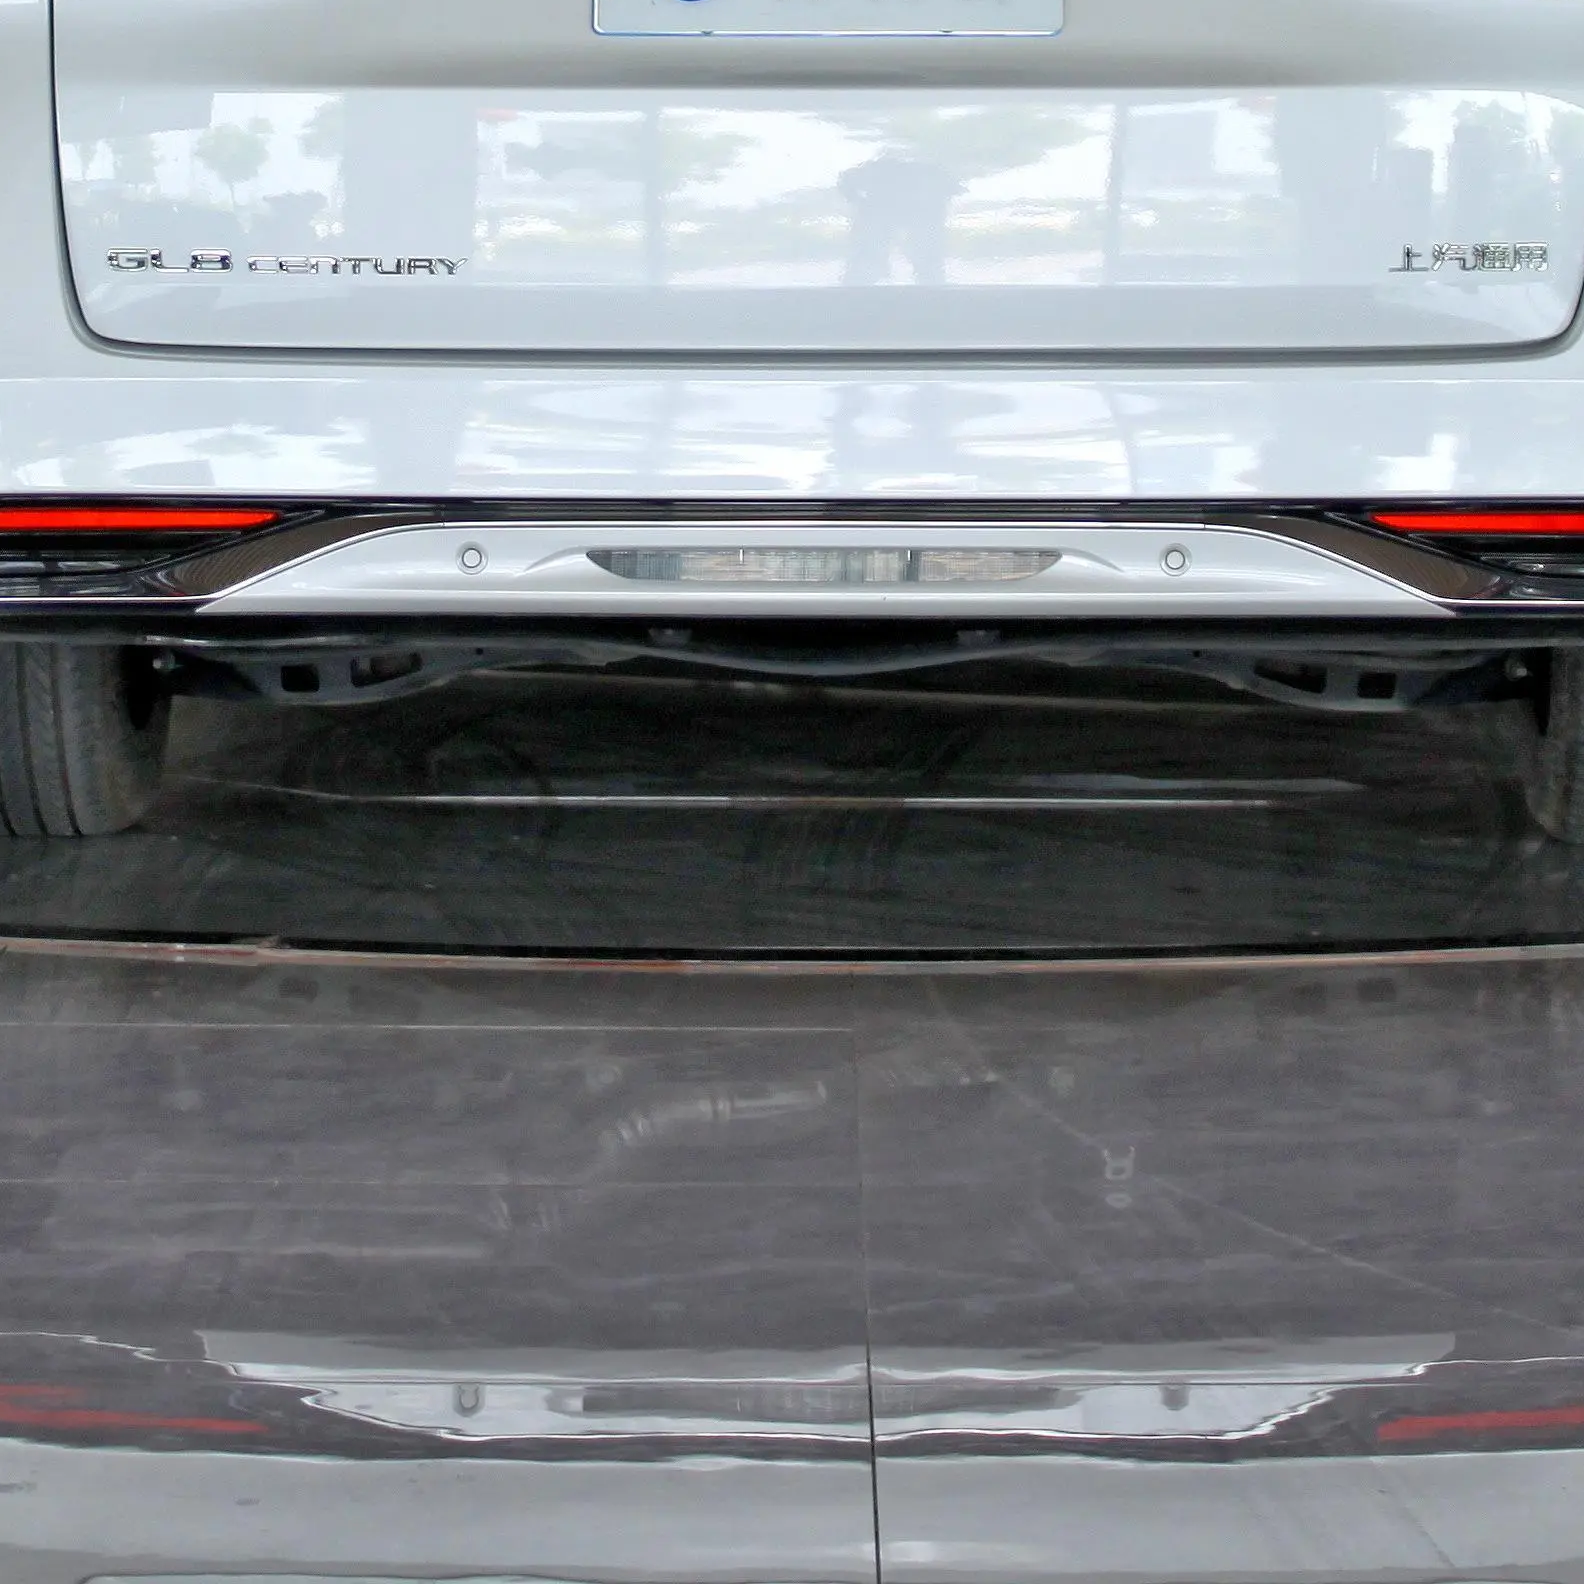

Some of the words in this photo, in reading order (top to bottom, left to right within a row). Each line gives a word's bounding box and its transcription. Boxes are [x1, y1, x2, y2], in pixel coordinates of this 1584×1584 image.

[106, 247, 234, 273] GL8
[245, 255, 470, 276] CENTURY
[1388, 241, 1549, 273] 上汽通用
